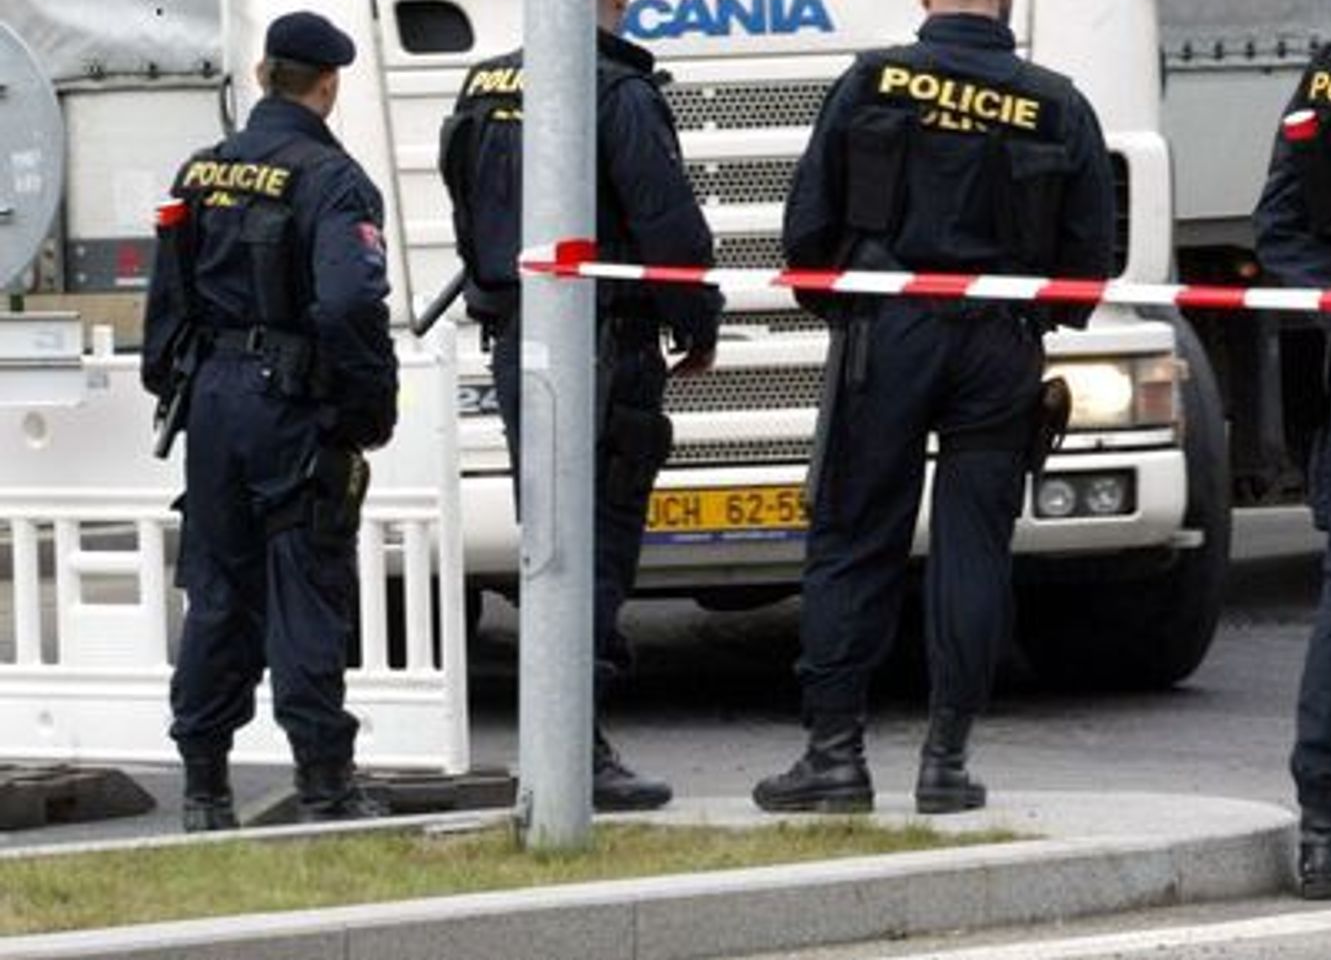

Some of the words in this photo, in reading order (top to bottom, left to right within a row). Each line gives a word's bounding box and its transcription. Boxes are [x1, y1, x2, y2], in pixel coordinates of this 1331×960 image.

[465, 69, 524, 97] POLI
[877, 65, 1040, 129] POLICIE
[183, 161, 291, 196] POLICIE
